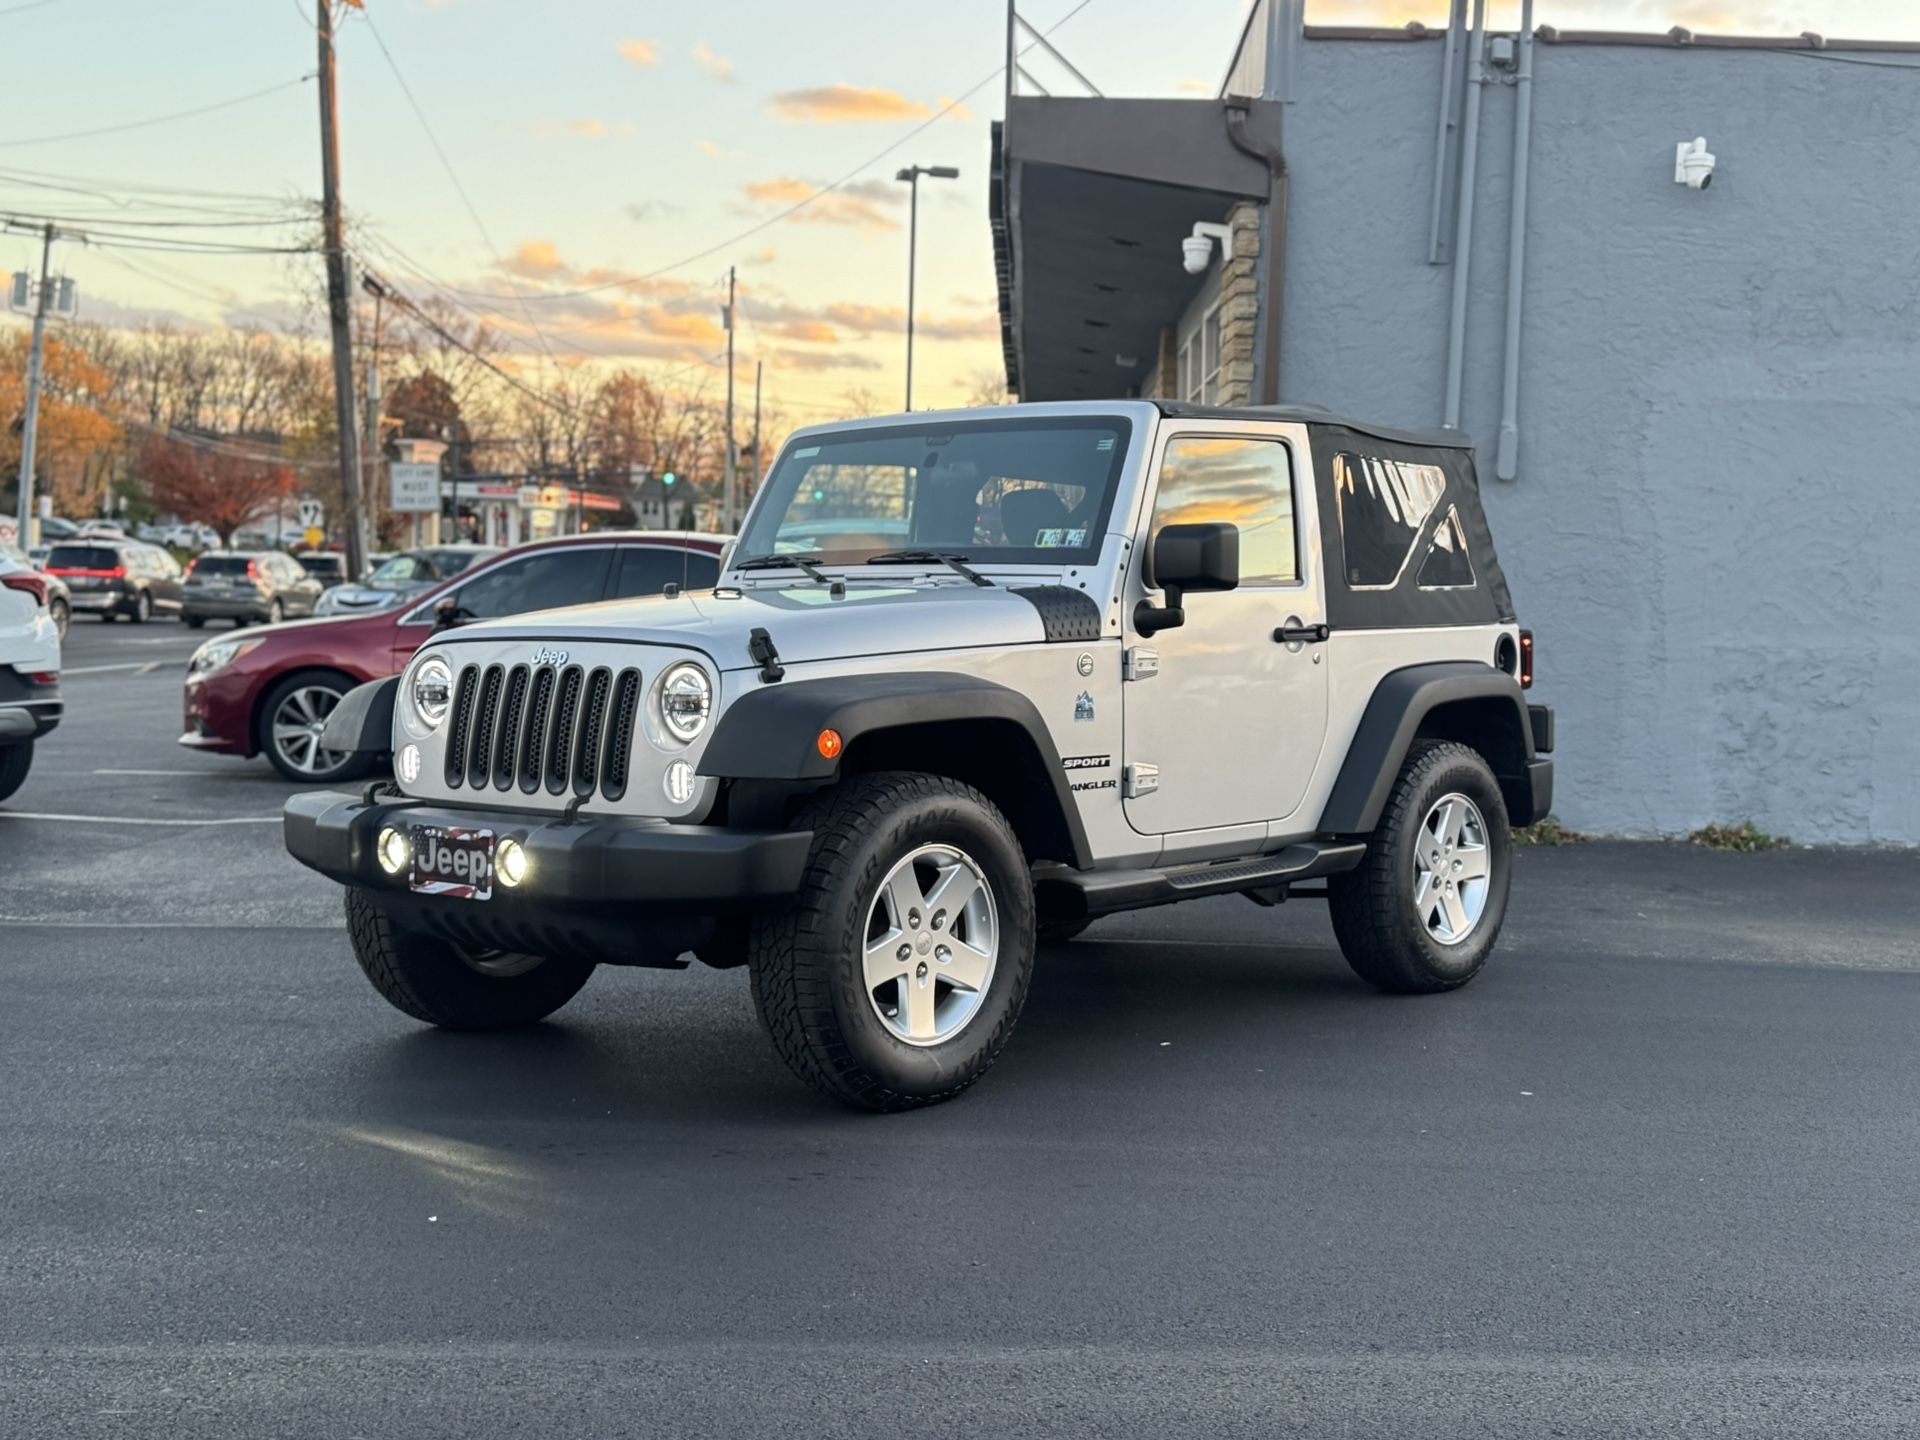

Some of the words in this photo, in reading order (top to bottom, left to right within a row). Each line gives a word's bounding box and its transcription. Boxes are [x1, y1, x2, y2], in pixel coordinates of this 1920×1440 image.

[531, 647, 569, 668] Jeep
[1063, 757, 1108, 768] SPORT
[1070, 780, 1117, 791] ANGLER
[888, 808, 959, 844] TRAIL
[418, 837, 487, 884] Jeep
[840, 853, 878, 1030] COURSER
